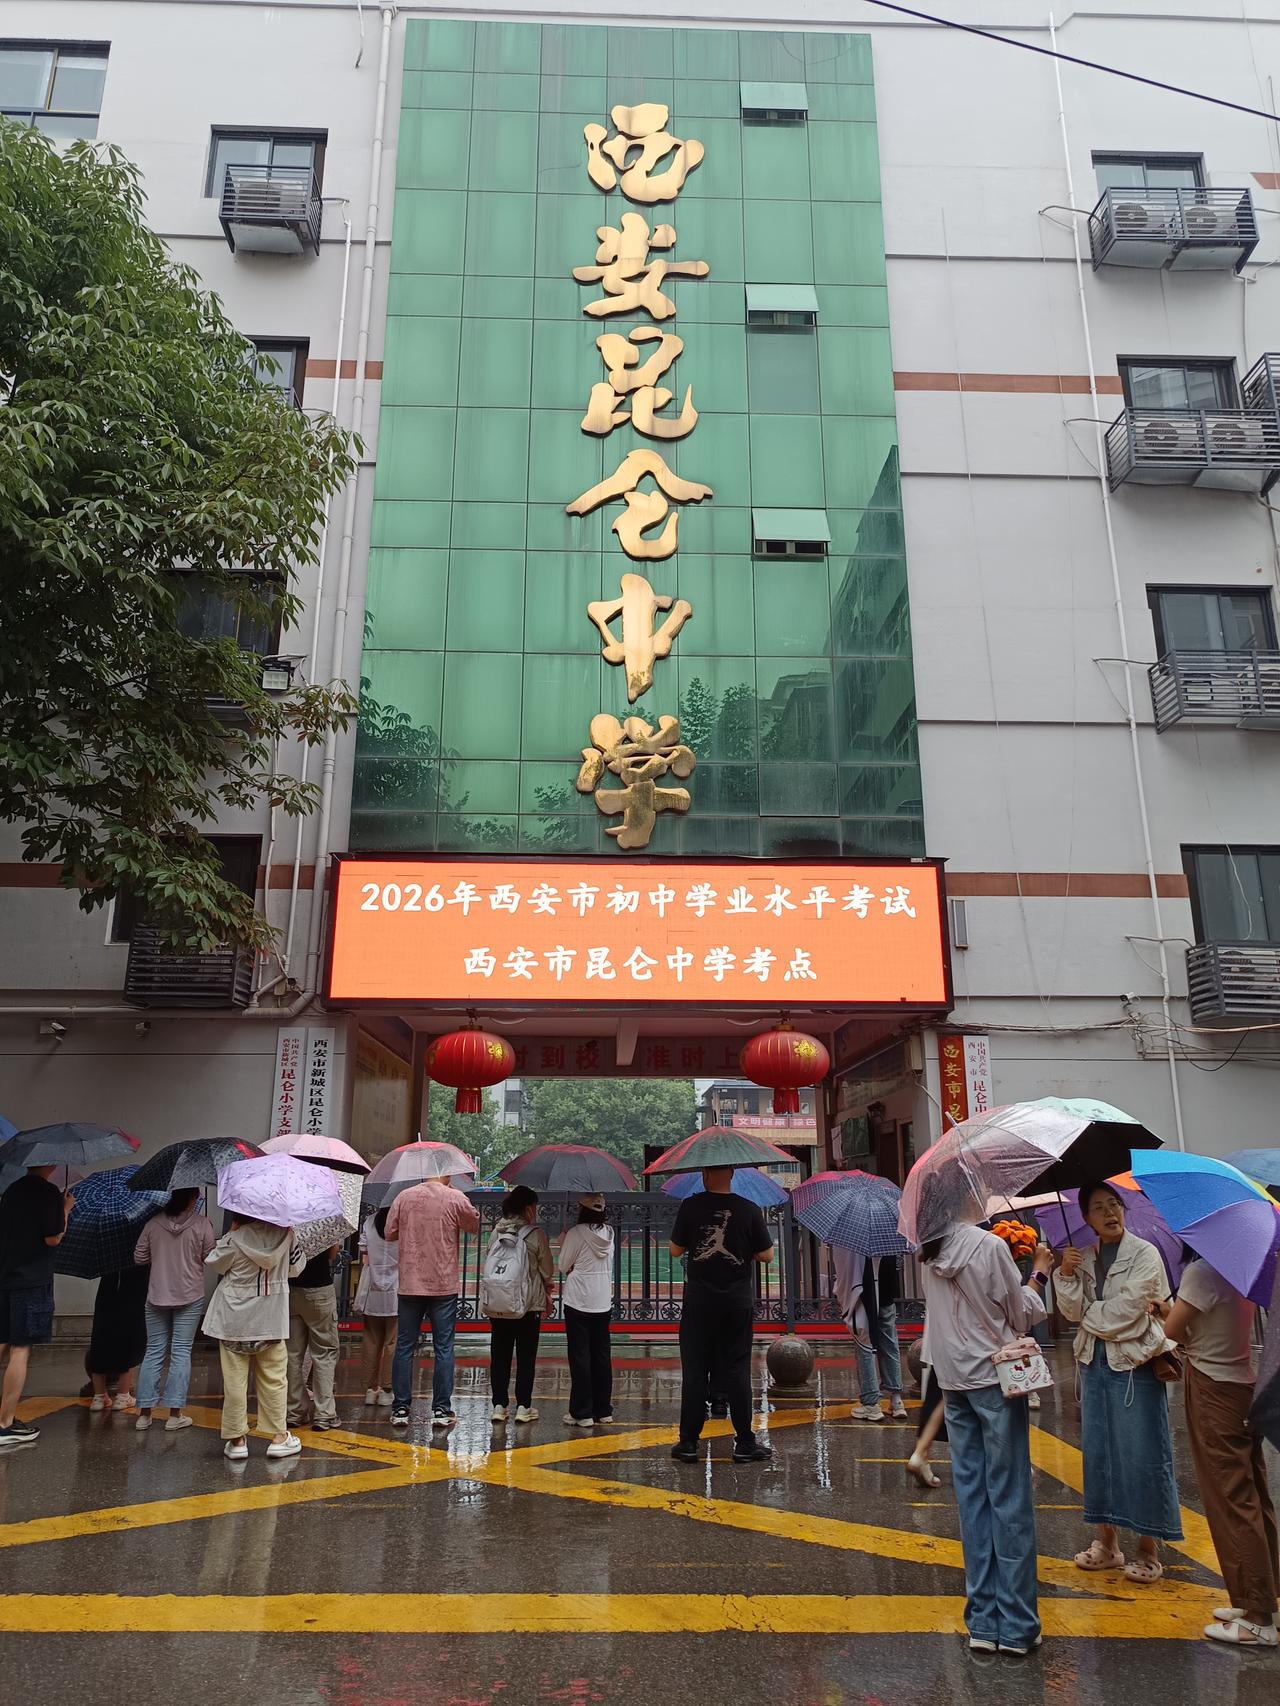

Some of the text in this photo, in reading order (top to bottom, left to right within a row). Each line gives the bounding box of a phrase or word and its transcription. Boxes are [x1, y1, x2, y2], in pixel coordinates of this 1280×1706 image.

[360, 882, 917, 919] 2026年西安市初中学业水平考试
[463, 946, 817, 983] 西安市昆仑中学考点
